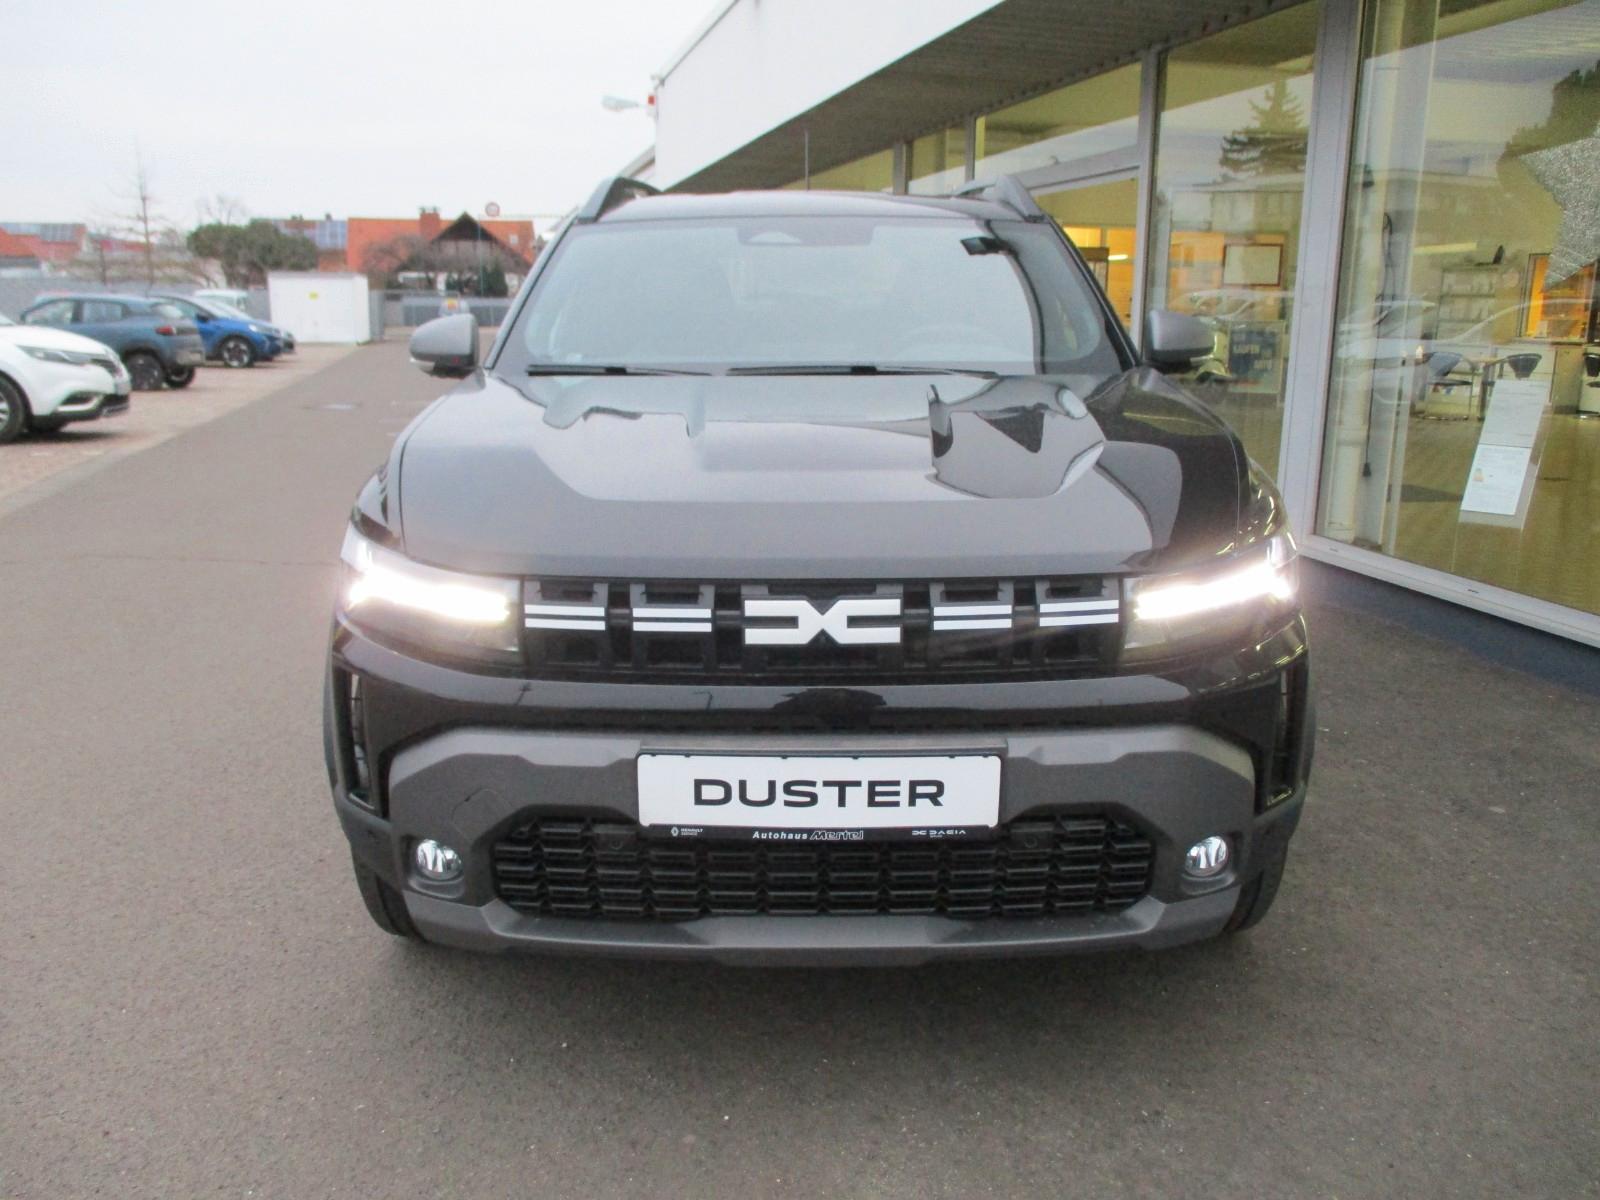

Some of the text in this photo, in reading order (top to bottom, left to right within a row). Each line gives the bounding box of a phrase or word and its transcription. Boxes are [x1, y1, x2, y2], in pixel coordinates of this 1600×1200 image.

[693, 778, 945, 808] DUSTER
[752, 830, 864, 841] Autohaus Mertel
